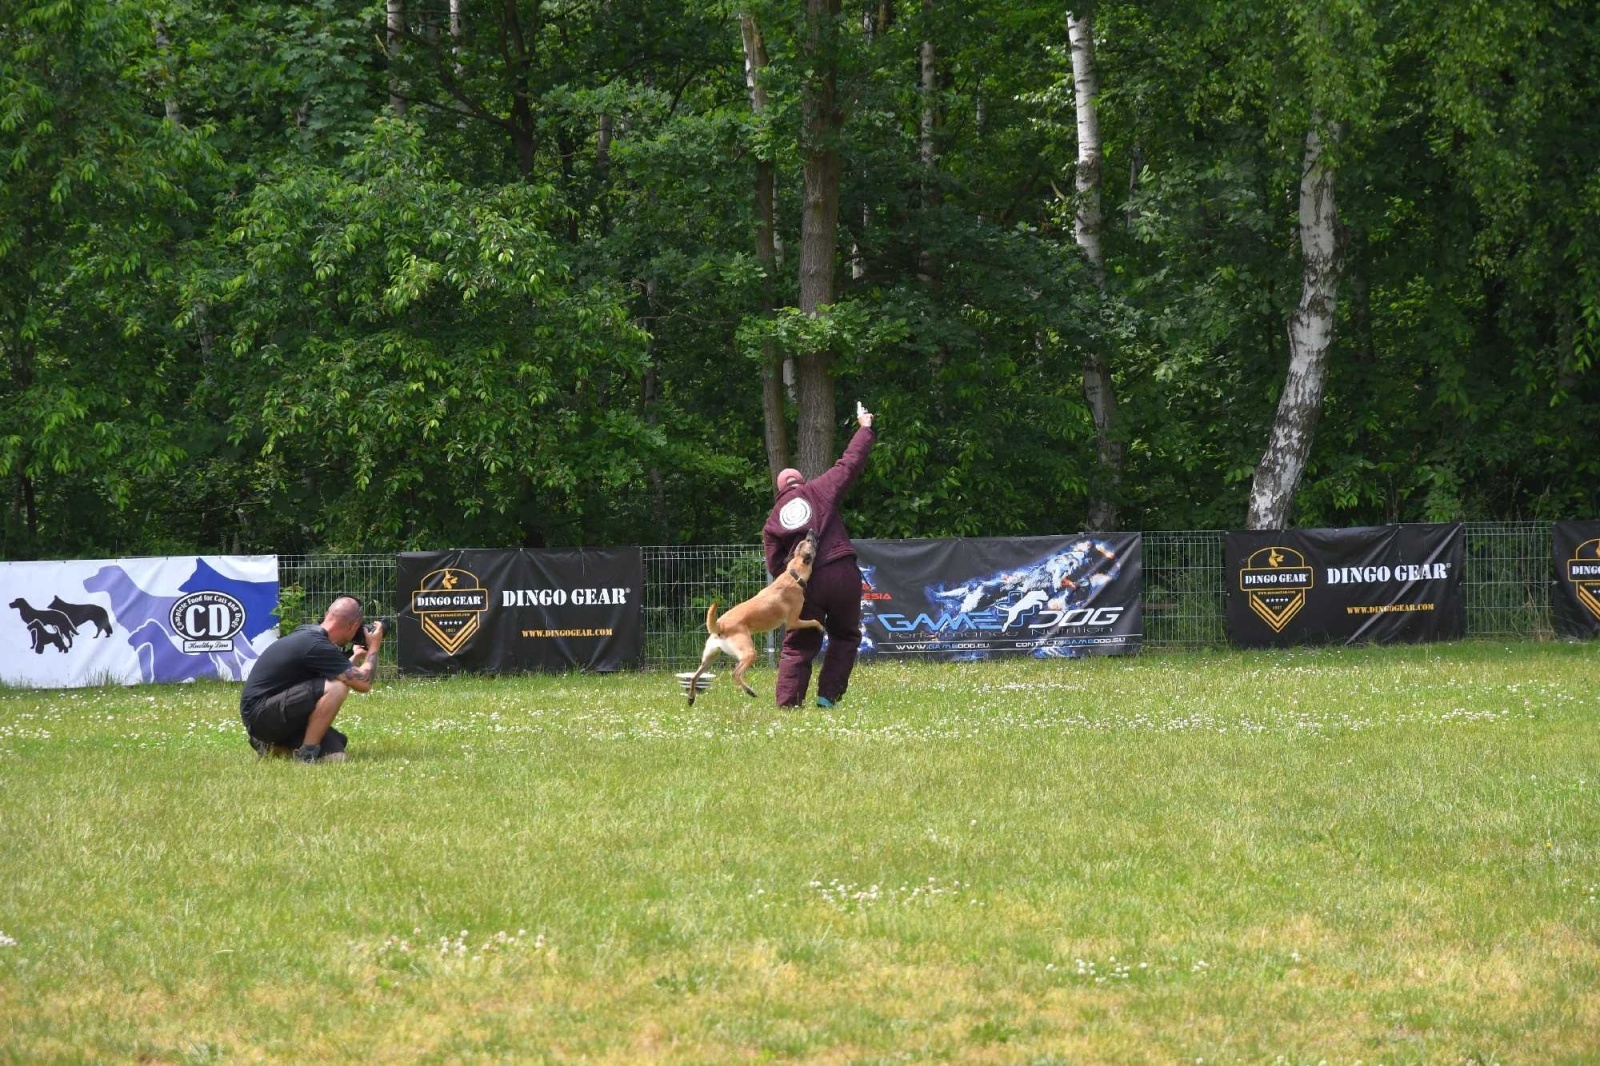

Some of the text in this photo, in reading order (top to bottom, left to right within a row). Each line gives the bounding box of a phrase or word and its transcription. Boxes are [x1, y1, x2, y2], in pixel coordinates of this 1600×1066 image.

[1245, 574, 1277, 584] DINGO
[1327, 566, 1391, 584] DINGO
[187, 595, 202, 604] Food
[214, 595, 227, 604] Cats
[417, 596, 451, 606] DINGO
[502, 588, 567, 607] DINGO
[861, 592, 892, 600] ESIA
[227, 602, 239, 611] and
[1346, 603, 1435, 614] WWW.DINGOGEAR.COM
[185, 604, 230, 636] CD
[231, 613, 241, 628] Dogs
[521, 628, 613, 638] WWW.DINGOGEAR.COM
